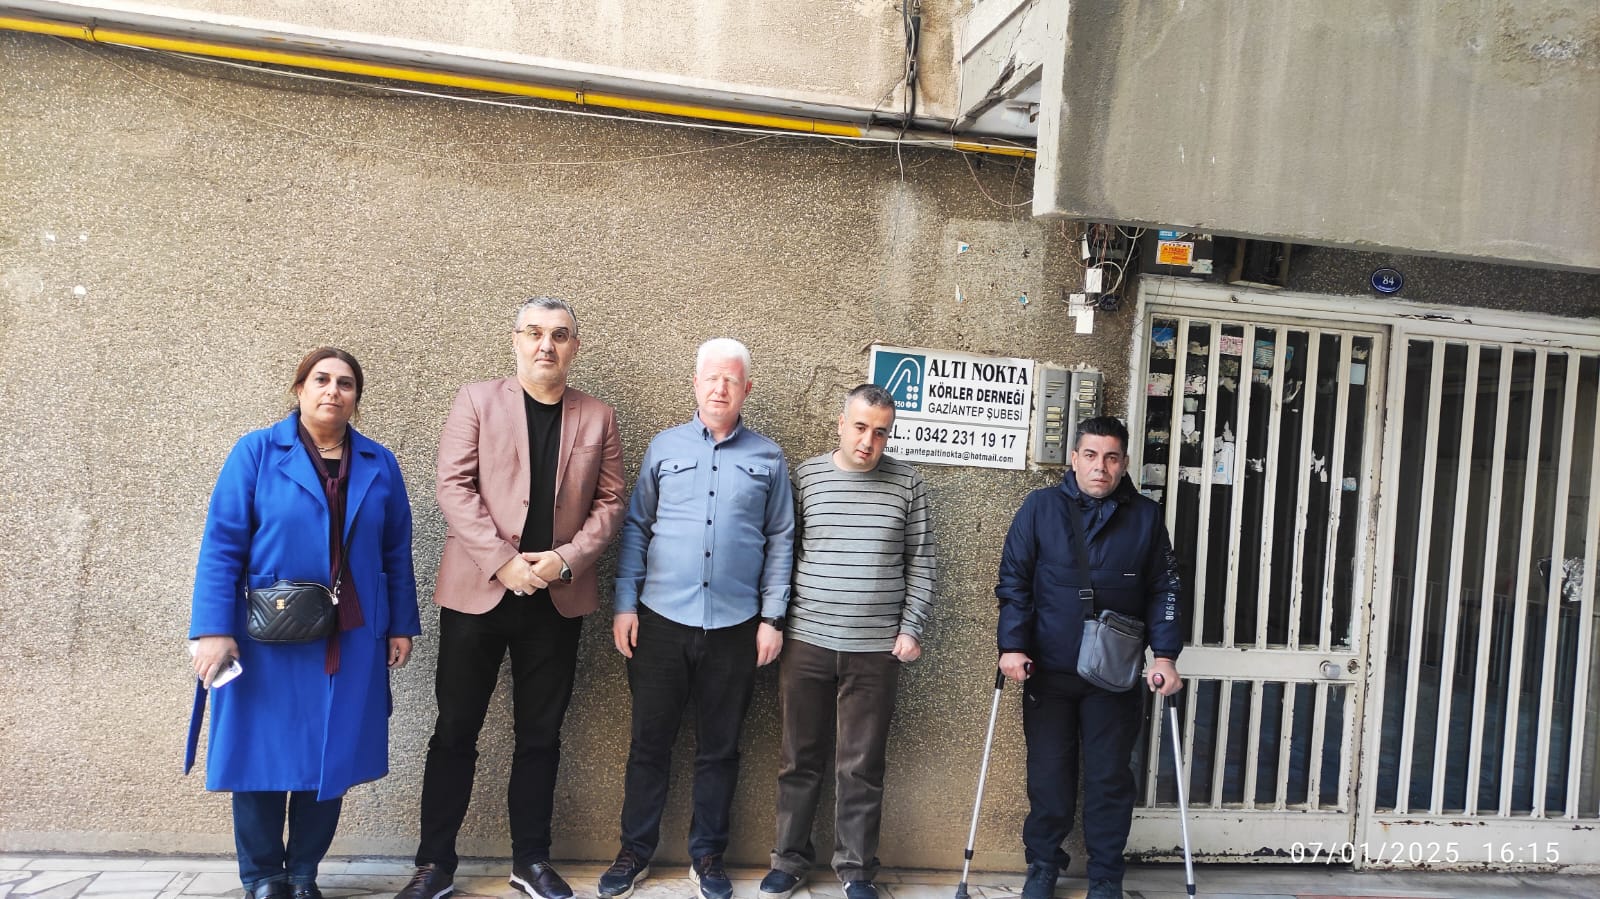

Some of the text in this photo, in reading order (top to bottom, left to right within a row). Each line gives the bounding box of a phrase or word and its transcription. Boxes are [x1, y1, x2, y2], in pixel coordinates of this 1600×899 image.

[1382, 274, 1395, 286] 84
[928, 359, 1029, 385] ALTI NOKTA
[928, 382, 1025, 406] KÖRLER DERNEĞİ
[928, 402, 1023, 421] GAZİANTEP ŞUBESİ
[915, 427, 948, 443] 0342
[952, 430, 975, 446] 231
[981, 432, 996, 447] 19
[1001, 434, 1017, 449] 17
